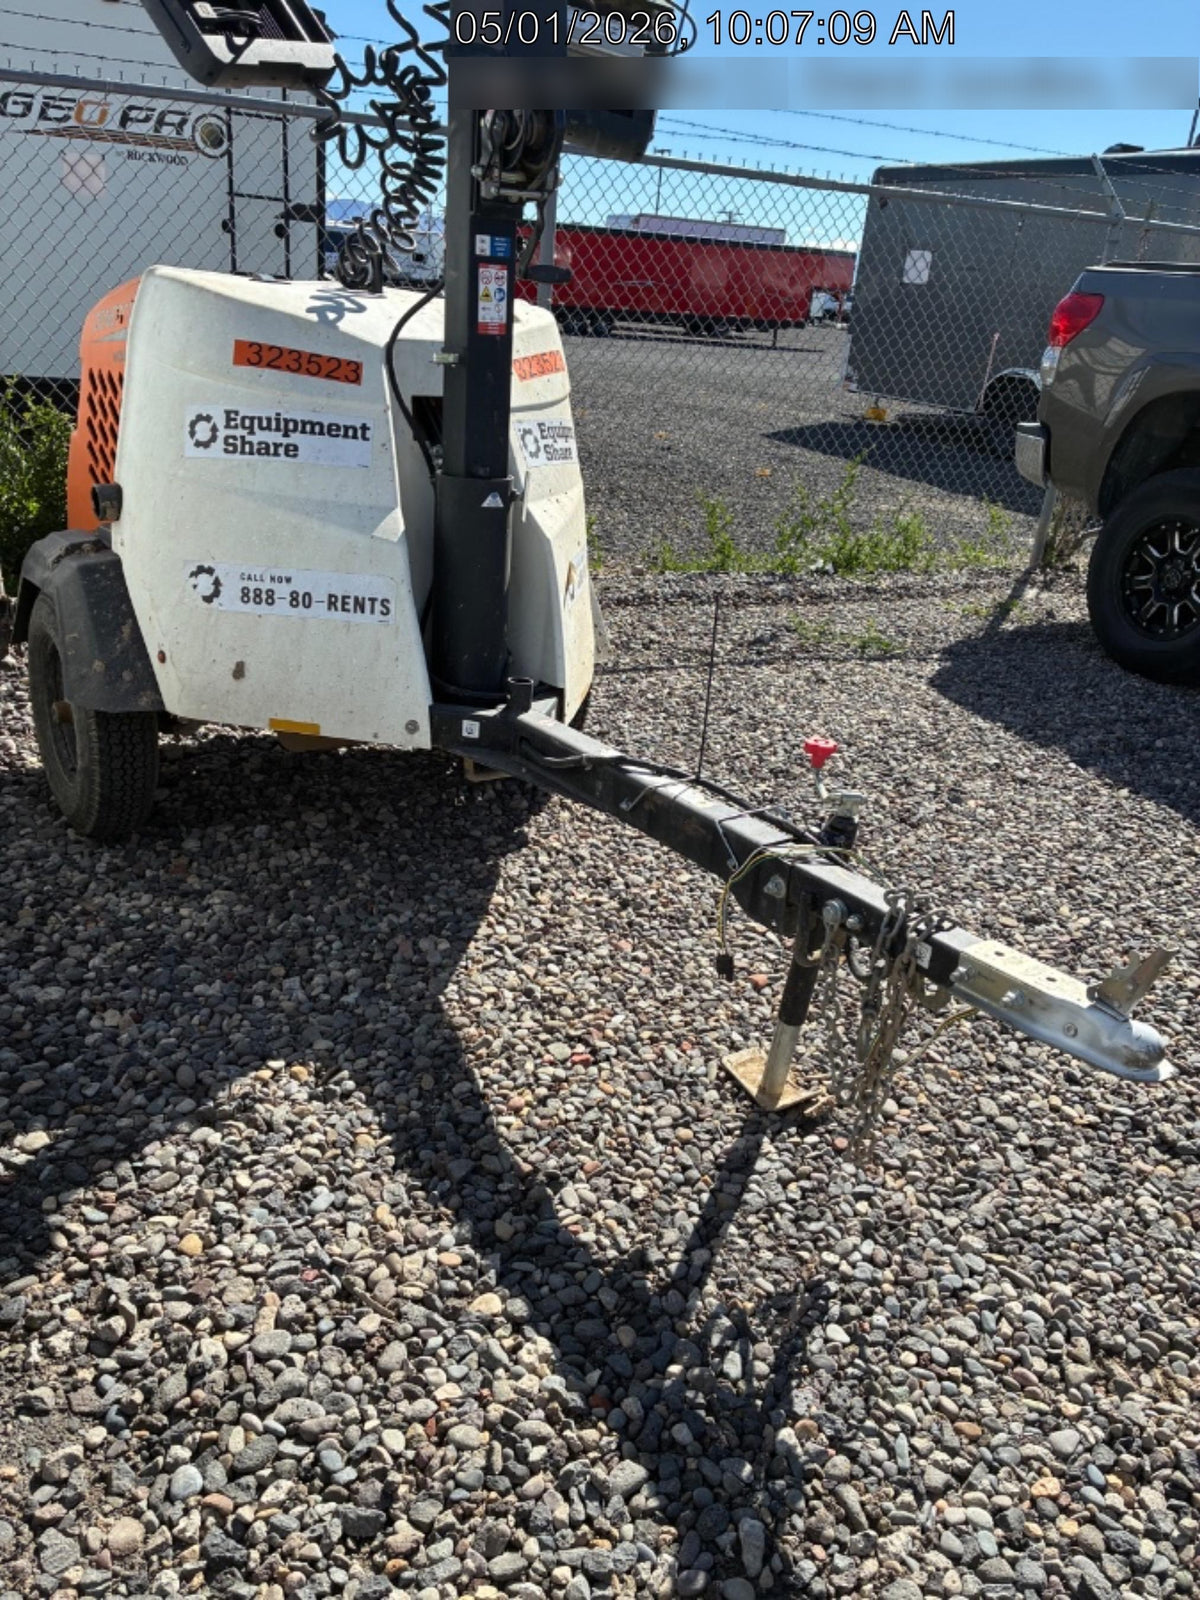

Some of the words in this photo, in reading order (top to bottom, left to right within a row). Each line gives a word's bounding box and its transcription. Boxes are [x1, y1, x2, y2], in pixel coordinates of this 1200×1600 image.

[0, 91, 111, 126] GEO
[127, 150, 189, 166] ROCKWOOD
[246, 342, 361, 383] 323523
[223, 409, 371, 442] Equipment
[536, 421, 573, 443] Equip
[223, 435, 299, 459] Share
[239, 572, 265, 583] CALL
[269, 574, 292, 584] NOW
[240, 586, 391, 616] 888-80-RENTS
